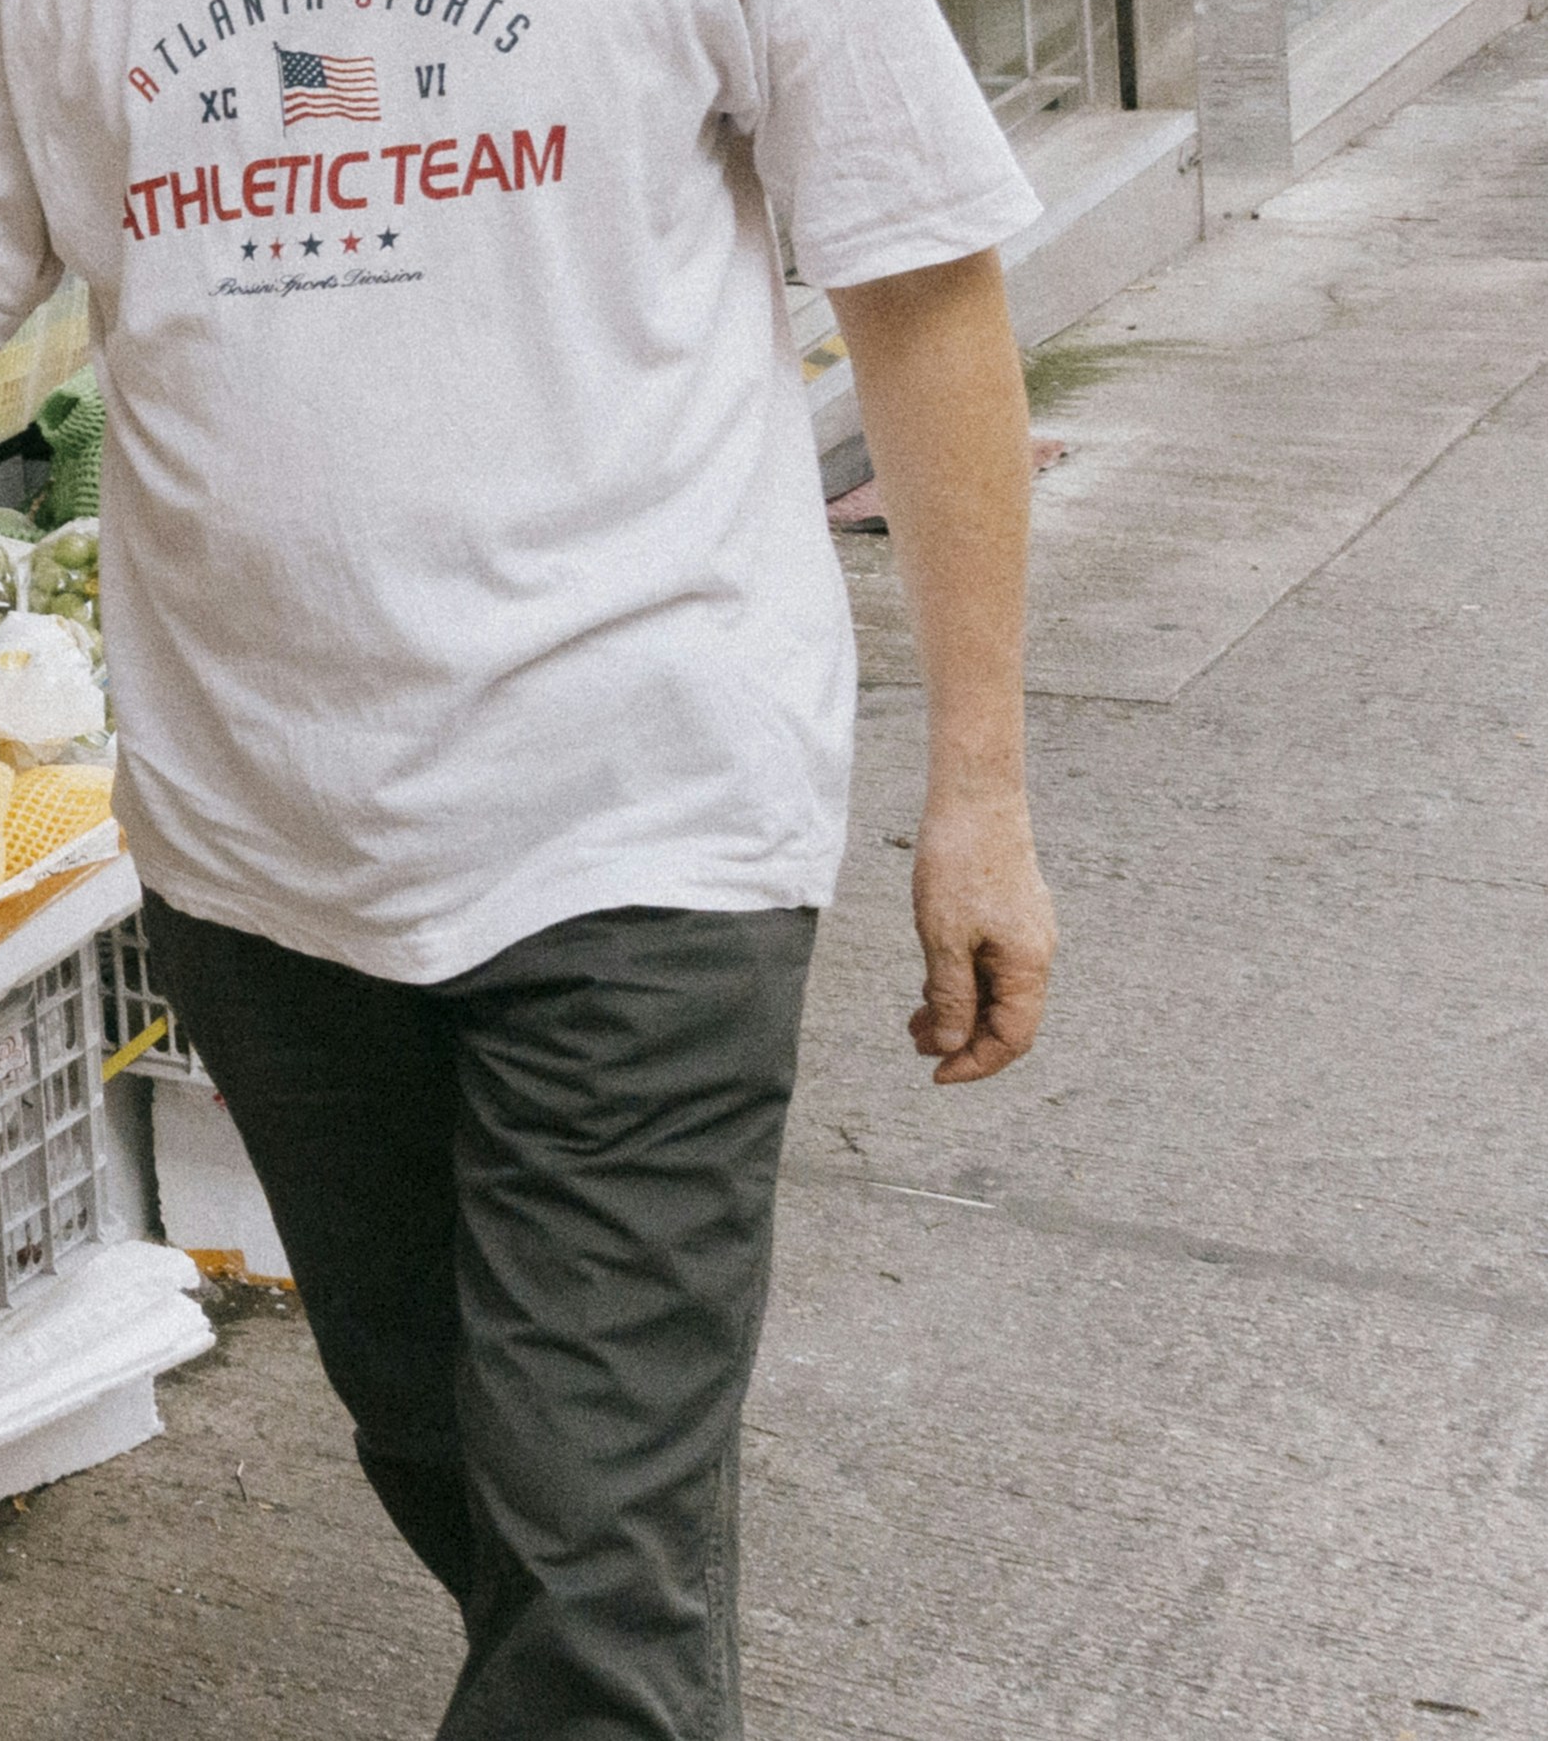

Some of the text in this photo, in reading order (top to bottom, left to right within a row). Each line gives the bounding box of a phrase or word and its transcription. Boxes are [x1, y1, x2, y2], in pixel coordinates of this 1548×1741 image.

[415, 63, 446, 99] VI
[200, 88, 238, 124] XC
[381, 125, 567, 205] TEAM
[275, 274, 340, 300] Sports
[340, 267, 425, 290] Division
